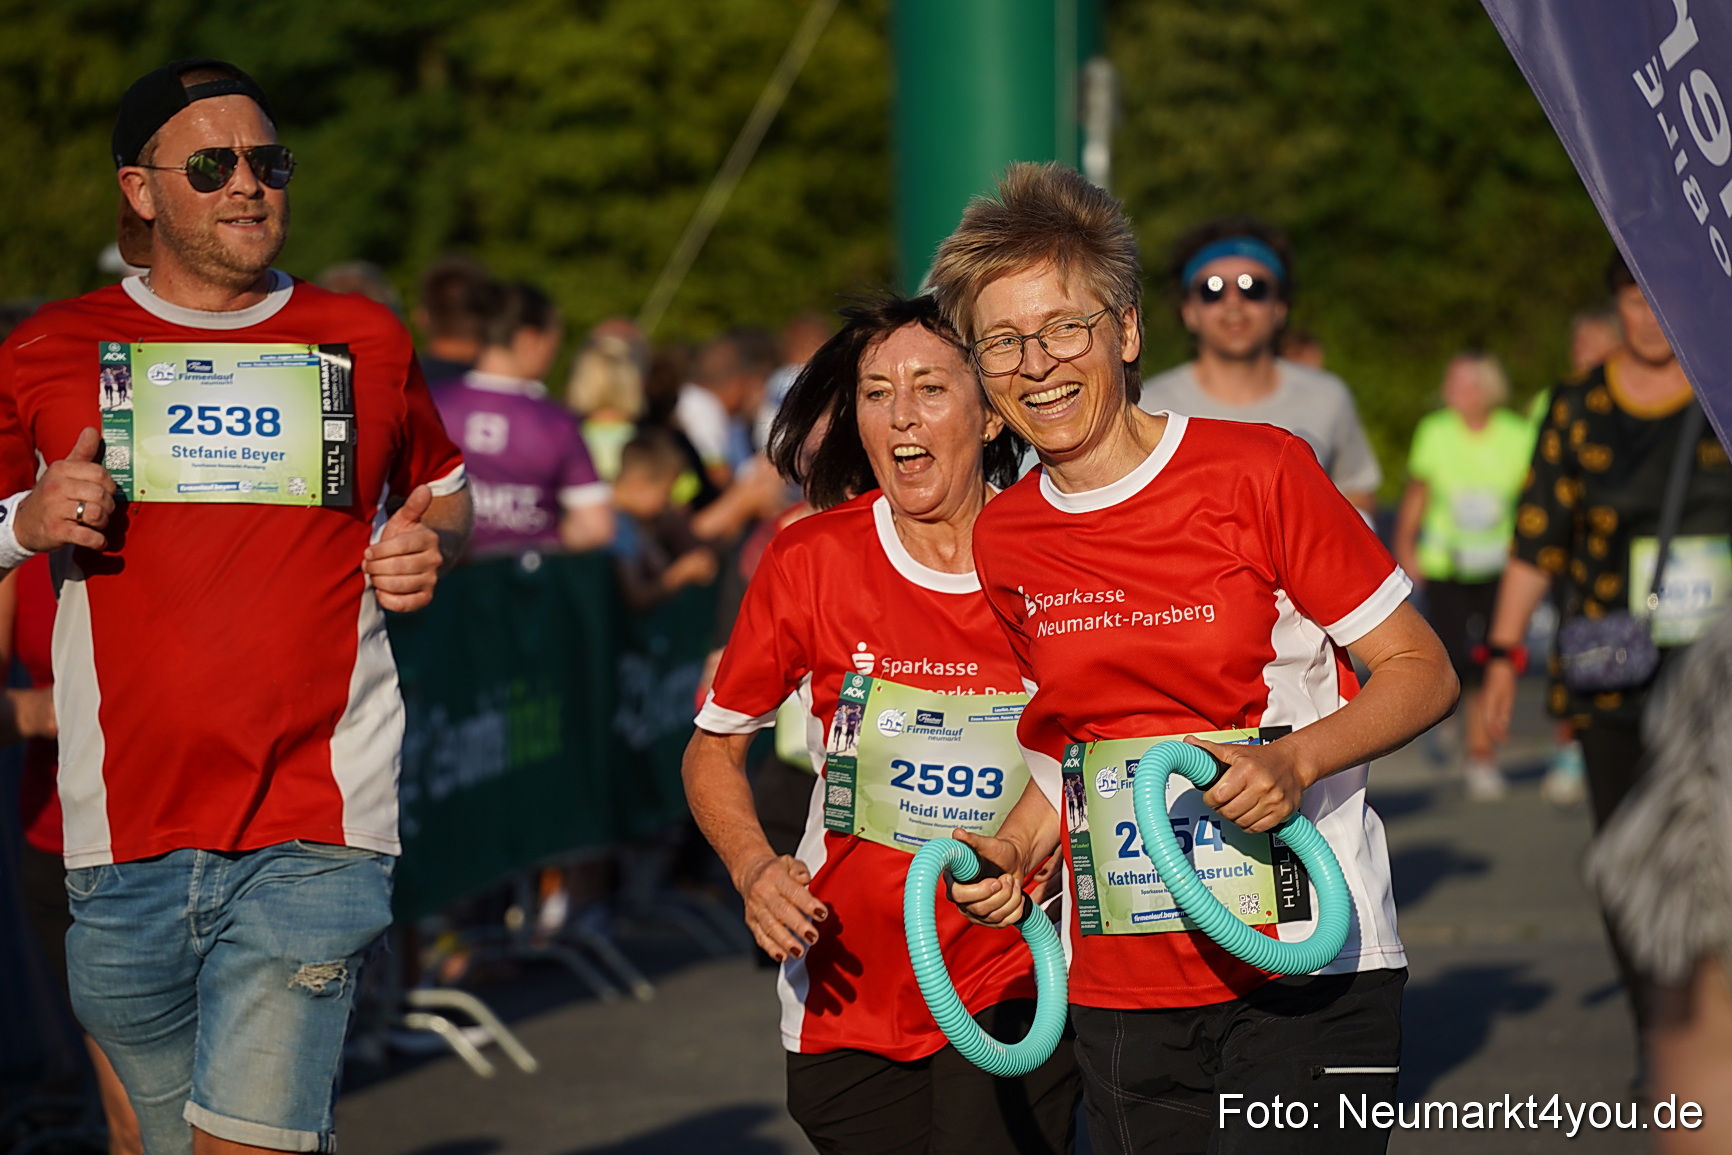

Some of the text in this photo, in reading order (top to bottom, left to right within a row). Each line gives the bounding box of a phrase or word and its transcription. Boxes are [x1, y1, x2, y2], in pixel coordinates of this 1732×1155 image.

[103, 352, 127, 361] AOK
[178, 373, 234, 382] Firmenlauf
[167, 404, 281, 437] 2538
[172, 445, 286, 463] Stefanie Beyer
[327, 445, 340, 495] HILTL
[1035, 588, 1125, 613] Sparkasse
[1037, 603, 1216, 638] Neumarkt-Parsberg
[881, 657, 979, 678] Sparkasse
[844, 687, 865, 699] AOK
[906, 725, 964, 737] Firmenlauf
[1063, 758, 1081, 768] AOK
[890, 759, 1004, 799] 2593
[899, 798, 996, 822] Heidi Walter
[1115, 814, 1226, 859] 254
[1107, 862, 1254, 887] Kathari asruck
[1280, 852, 1296, 908] HILTL
[1140, 888, 1164, 896] Sparkasse
